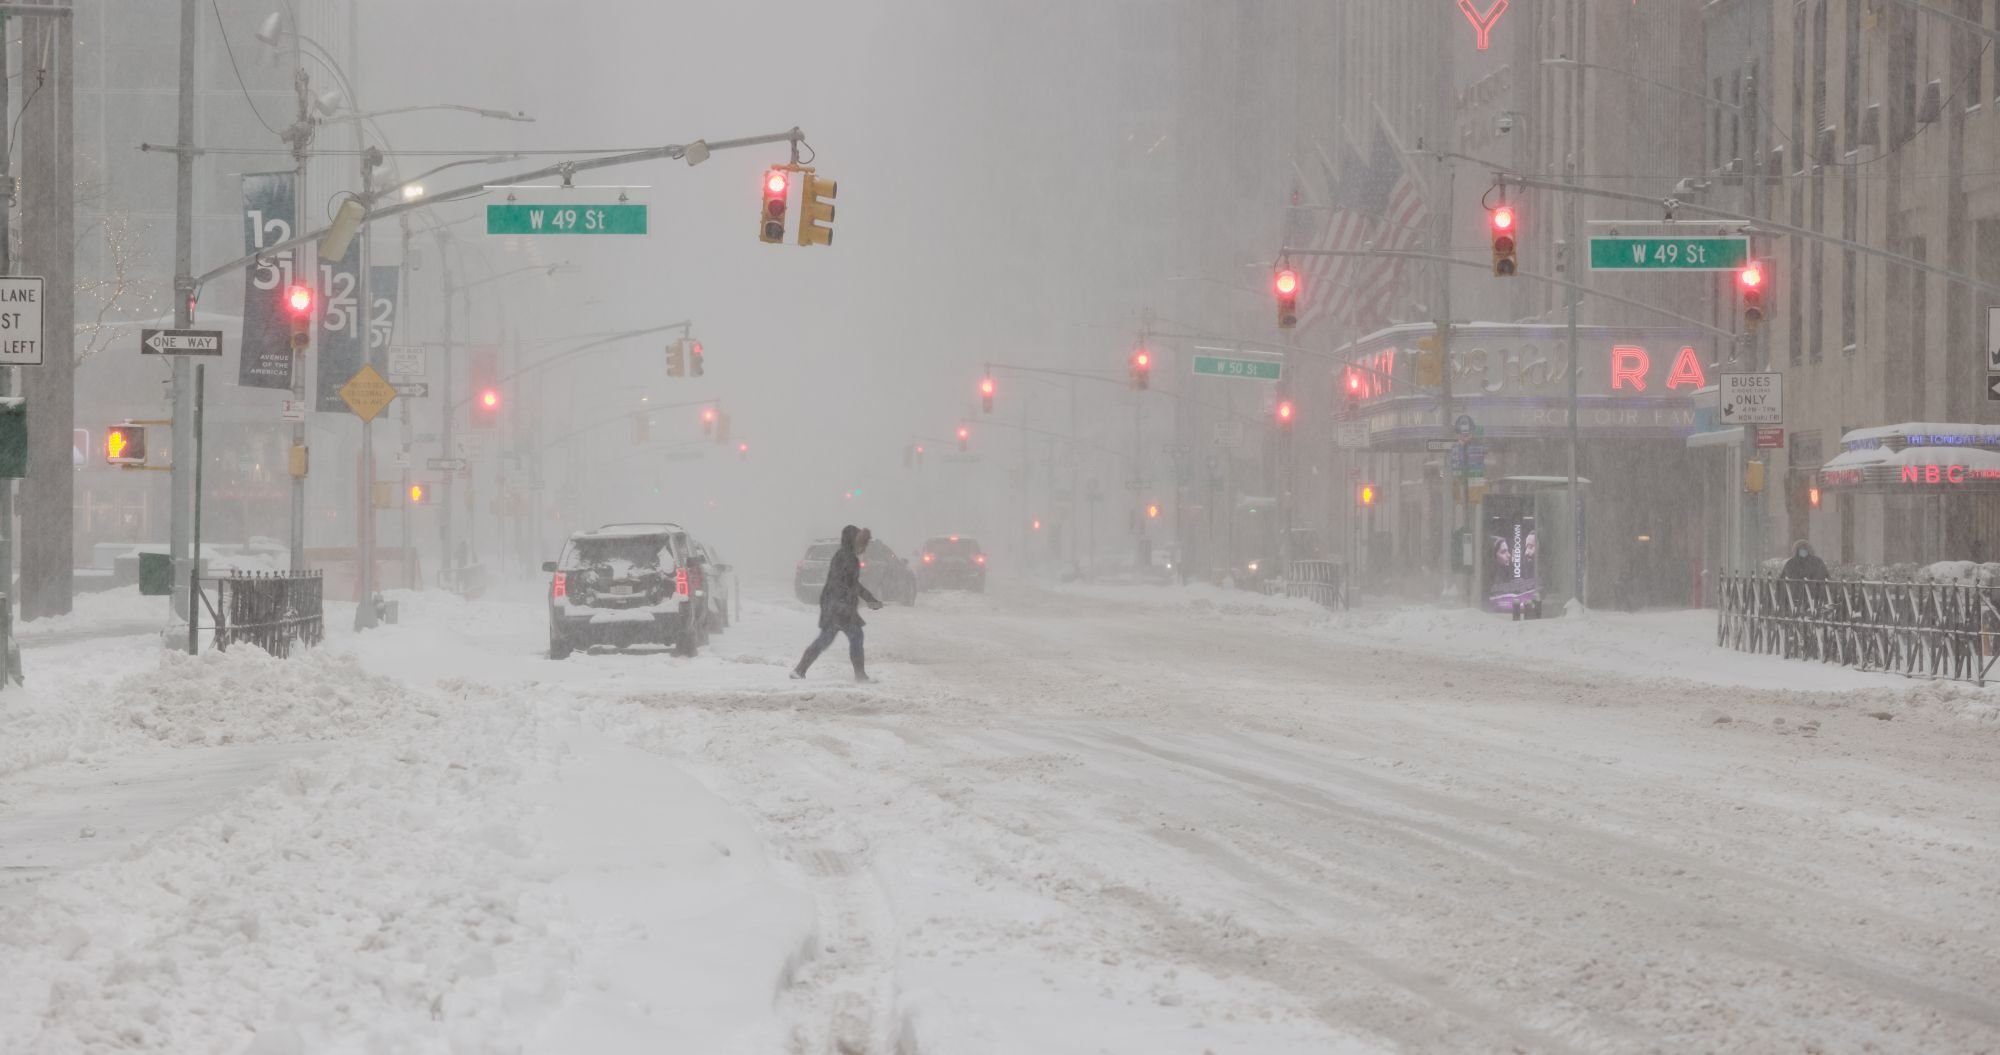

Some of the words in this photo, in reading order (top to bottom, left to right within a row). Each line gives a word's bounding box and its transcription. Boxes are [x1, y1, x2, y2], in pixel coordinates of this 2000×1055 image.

[530, 210, 544, 229] W
[552, 210, 577, 229] 49
[585, 210, 605, 229] St
[1632, 244, 1646, 263] W
[1654, 244, 1678, 263] 49
[1686, 244, 1706, 263] St
[320, 265, 357, 304] 12
[1, 288, 36, 302] LANE
[323, 301, 358, 338] 51
[4, 340, 36, 353] LEFT
[153, 336, 176, 347] ONE
[188, 337, 212, 348] WAY
[250, 368, 289, 377] AMERICAS
[1217, 361, 1225, 373] W
[1229, 362, 1243, 374] 50
[1246, 363, 1257, 375] St
[1731, 376, 1771, 387] BUSES
[1736, 394, 1767, 405] ONLY
[1901, 464, 1964, 483] NBC
